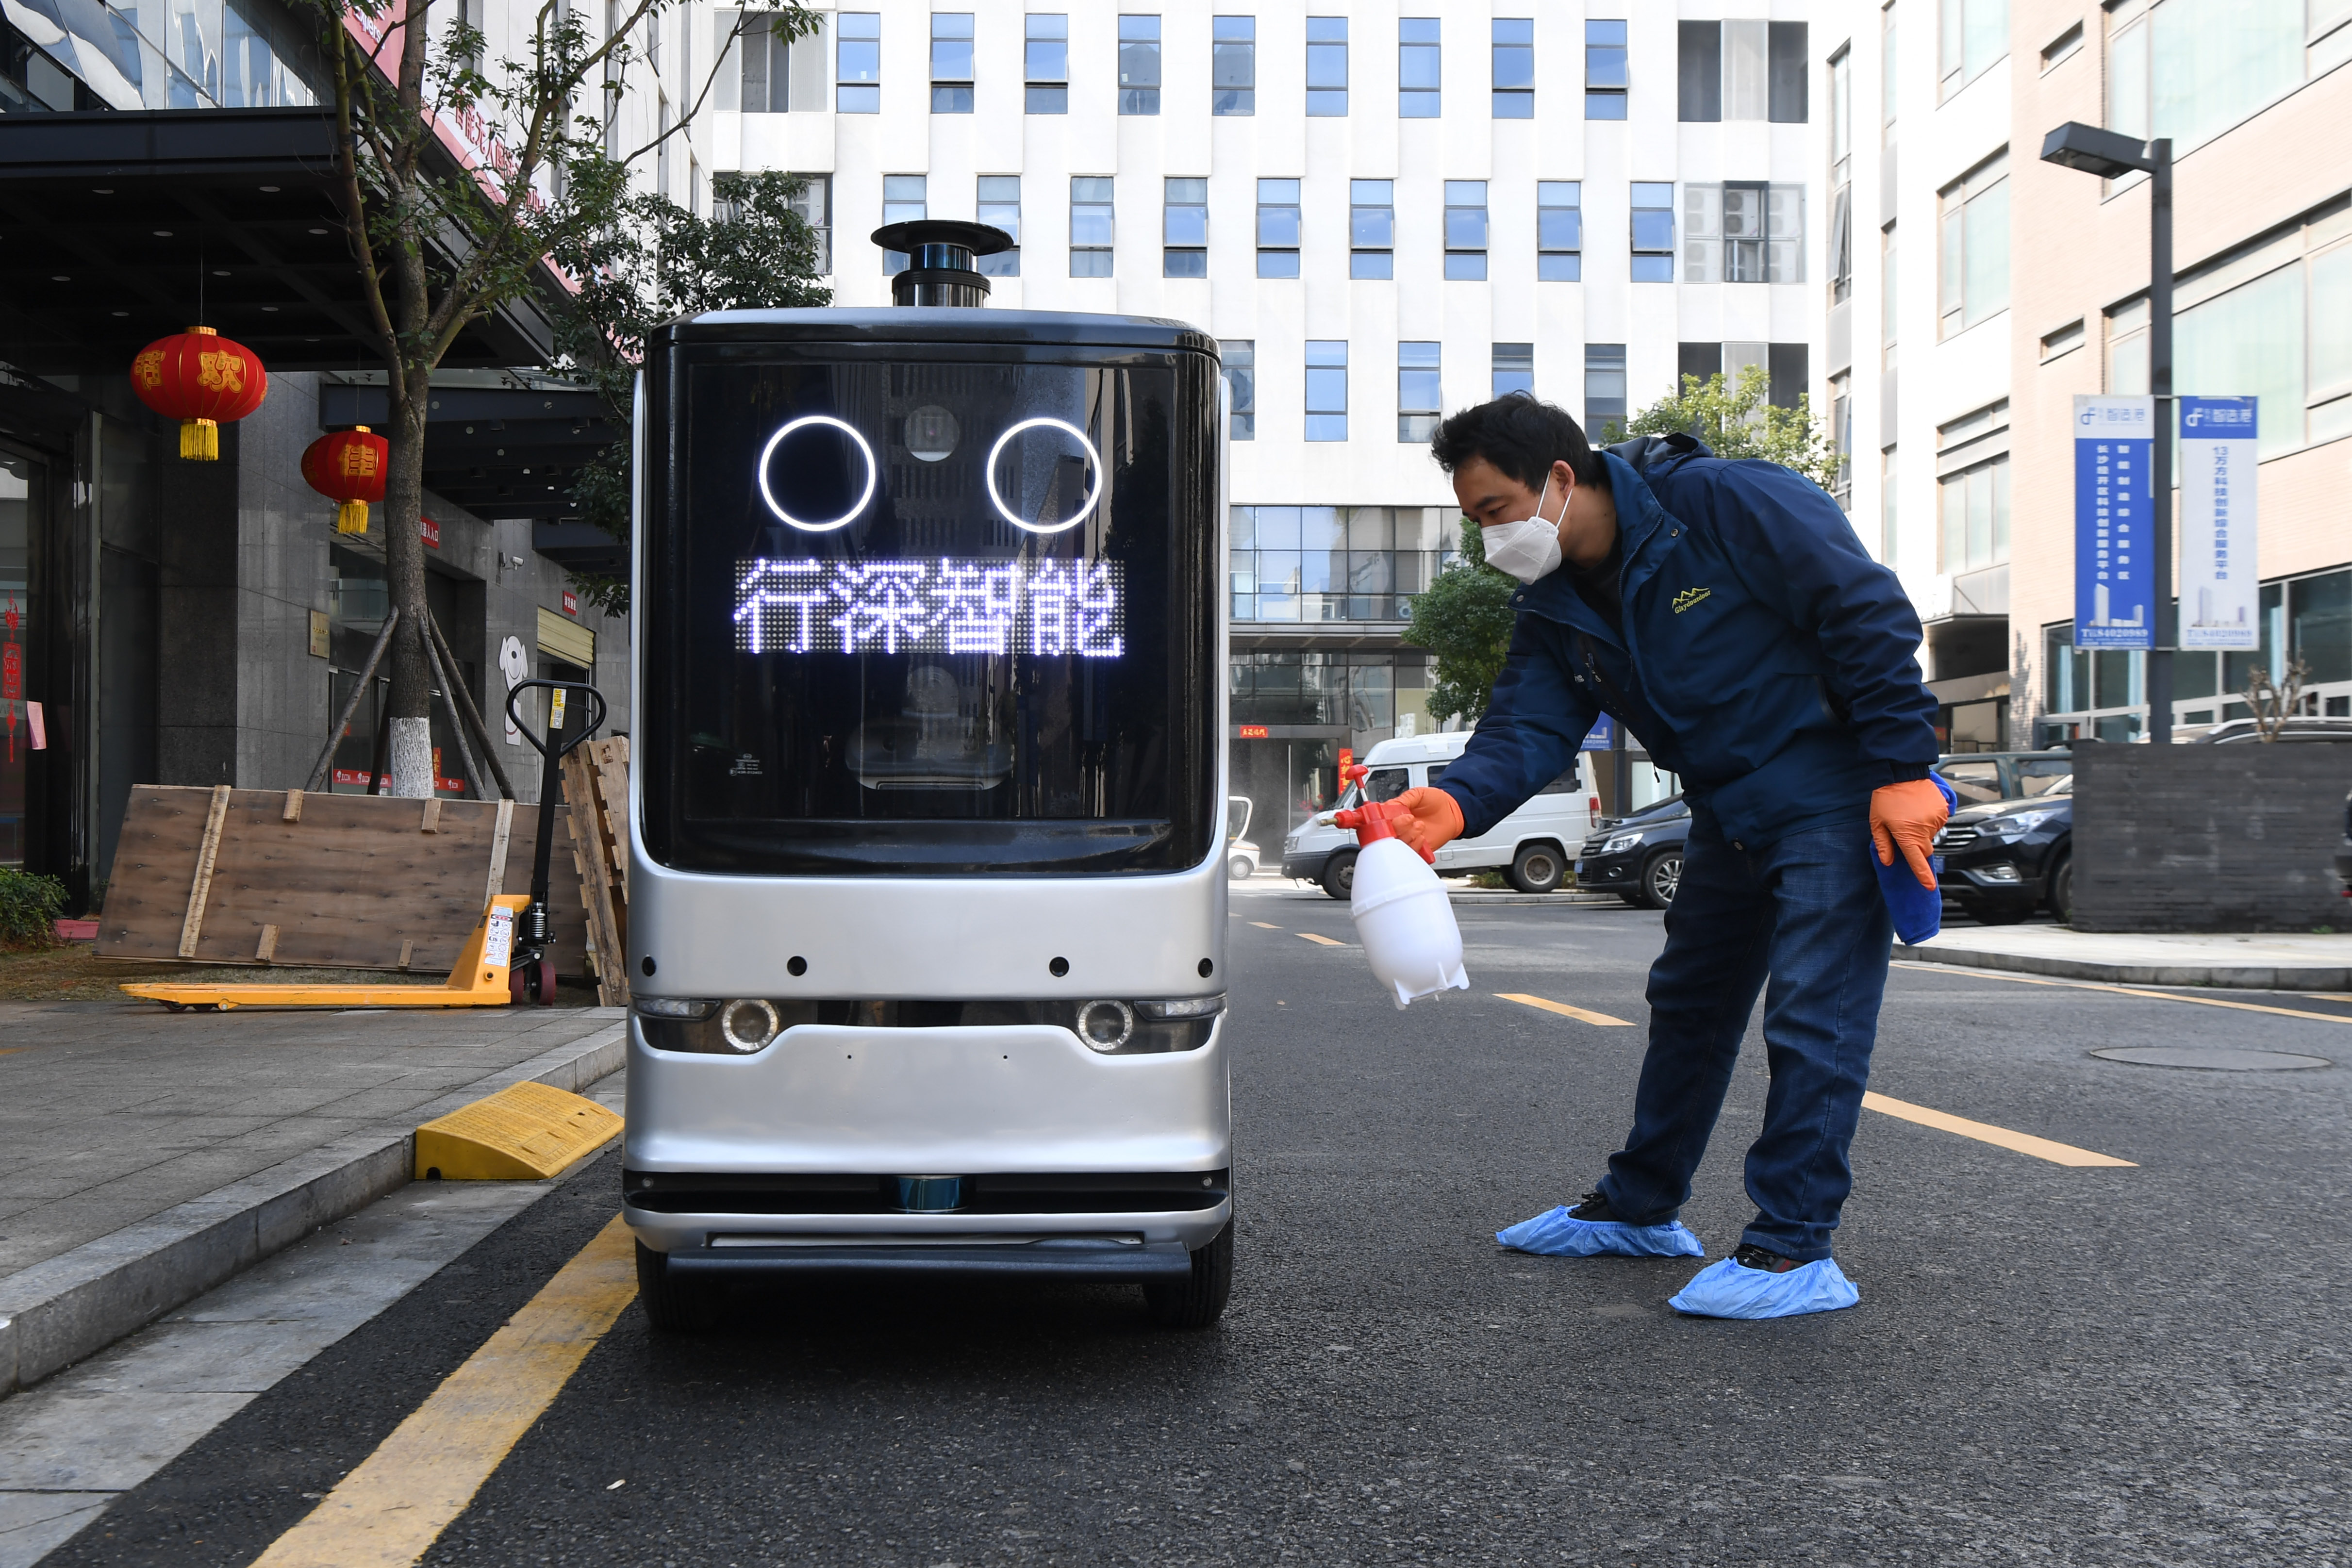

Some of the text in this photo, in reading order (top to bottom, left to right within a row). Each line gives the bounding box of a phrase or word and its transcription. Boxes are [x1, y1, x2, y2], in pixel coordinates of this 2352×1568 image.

[197, 349, 244, 393] 欢
[337, 444, 376, 477] 佳
[734, 557, 1121, 656] 行深智能
